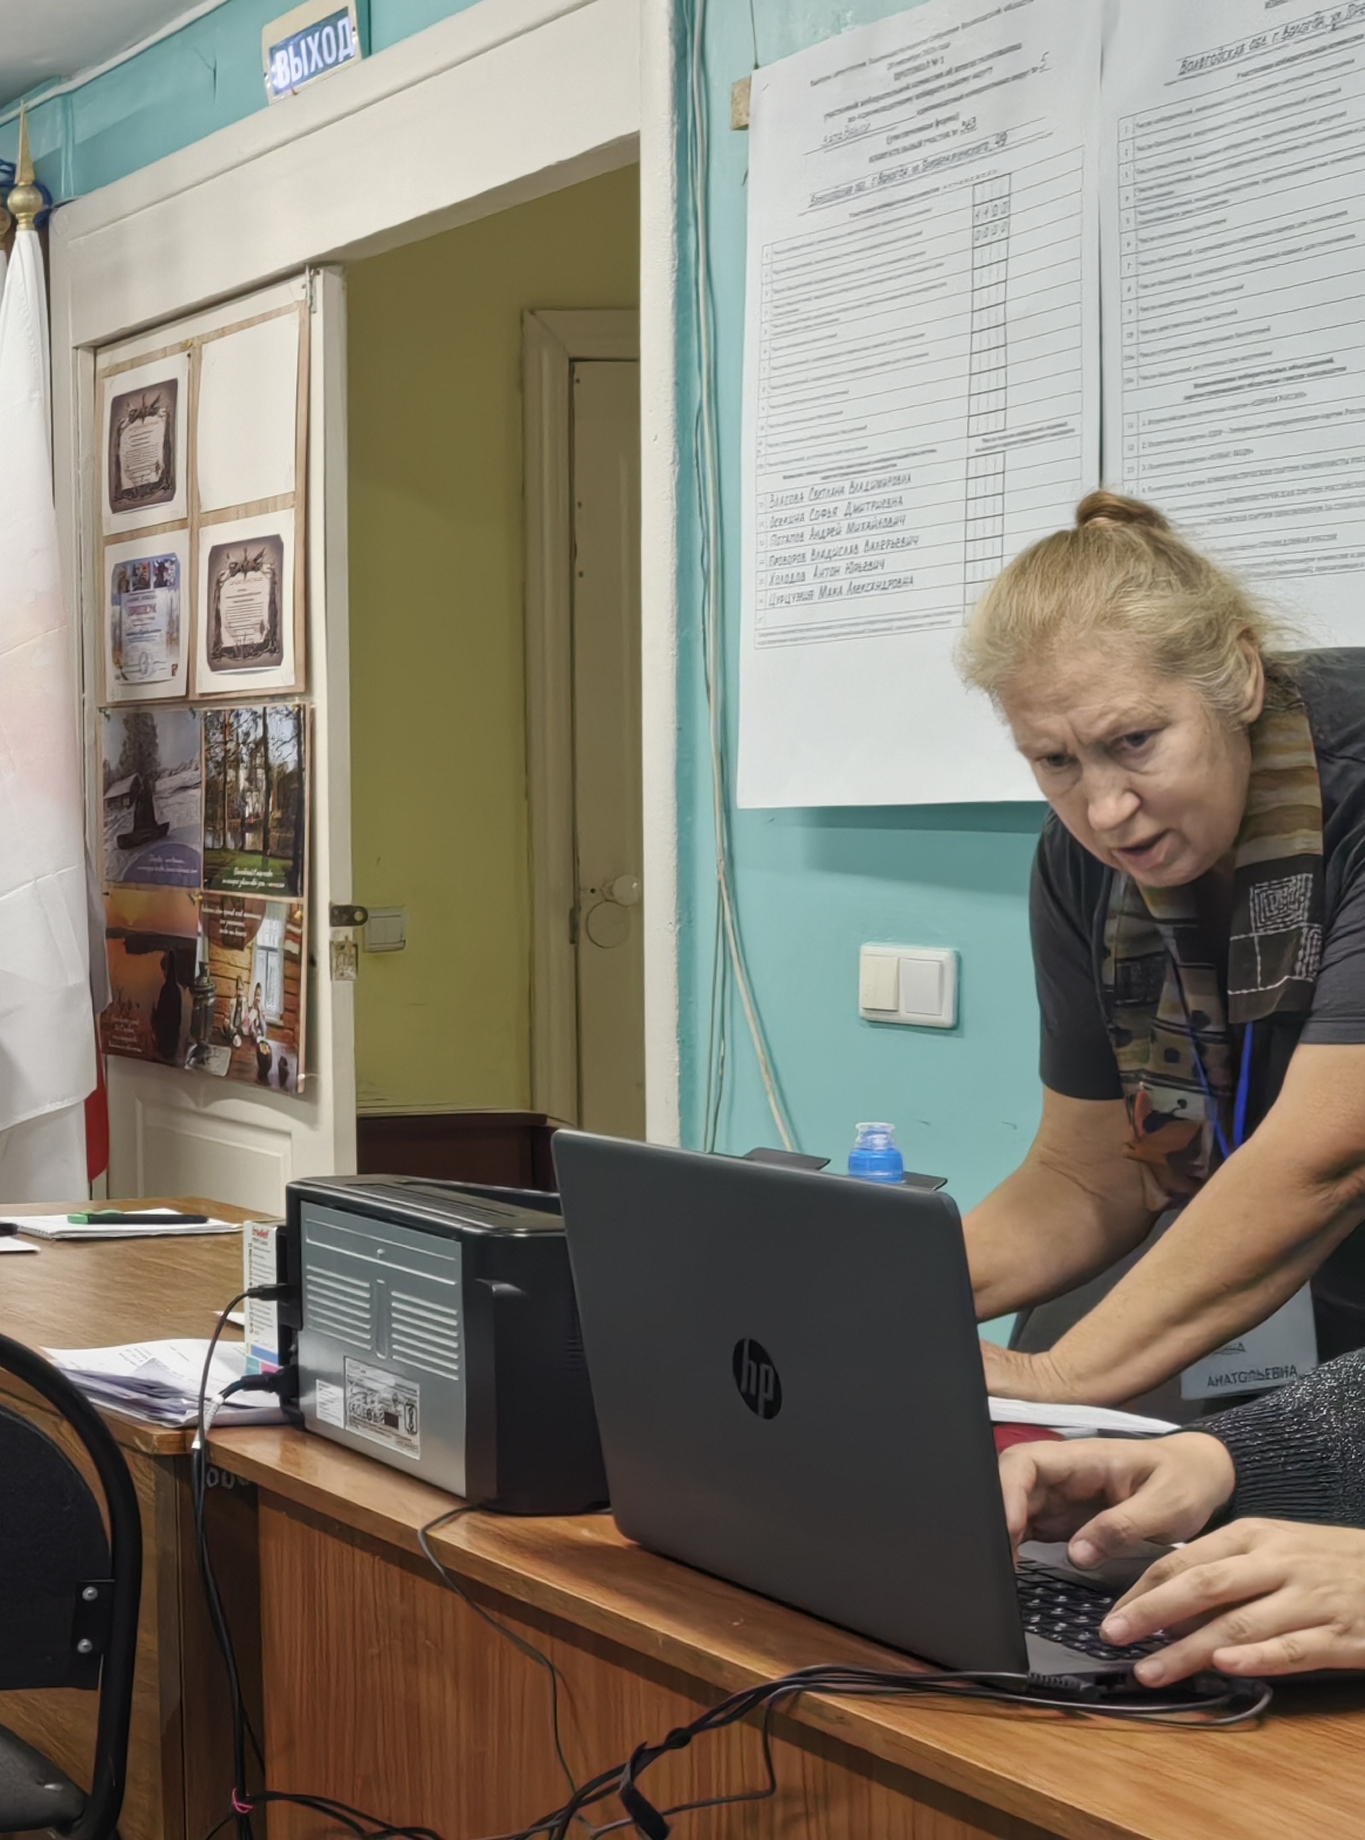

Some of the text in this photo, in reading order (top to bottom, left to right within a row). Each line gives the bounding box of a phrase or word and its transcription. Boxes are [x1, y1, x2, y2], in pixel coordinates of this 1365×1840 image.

[271, 16, 355, 88] ВЫХОД
[809, 506, 839, 522] СОФЬЯ
[813, 564, 841, 580] АНТОН
[740, 1339, 775, 1417] hp
